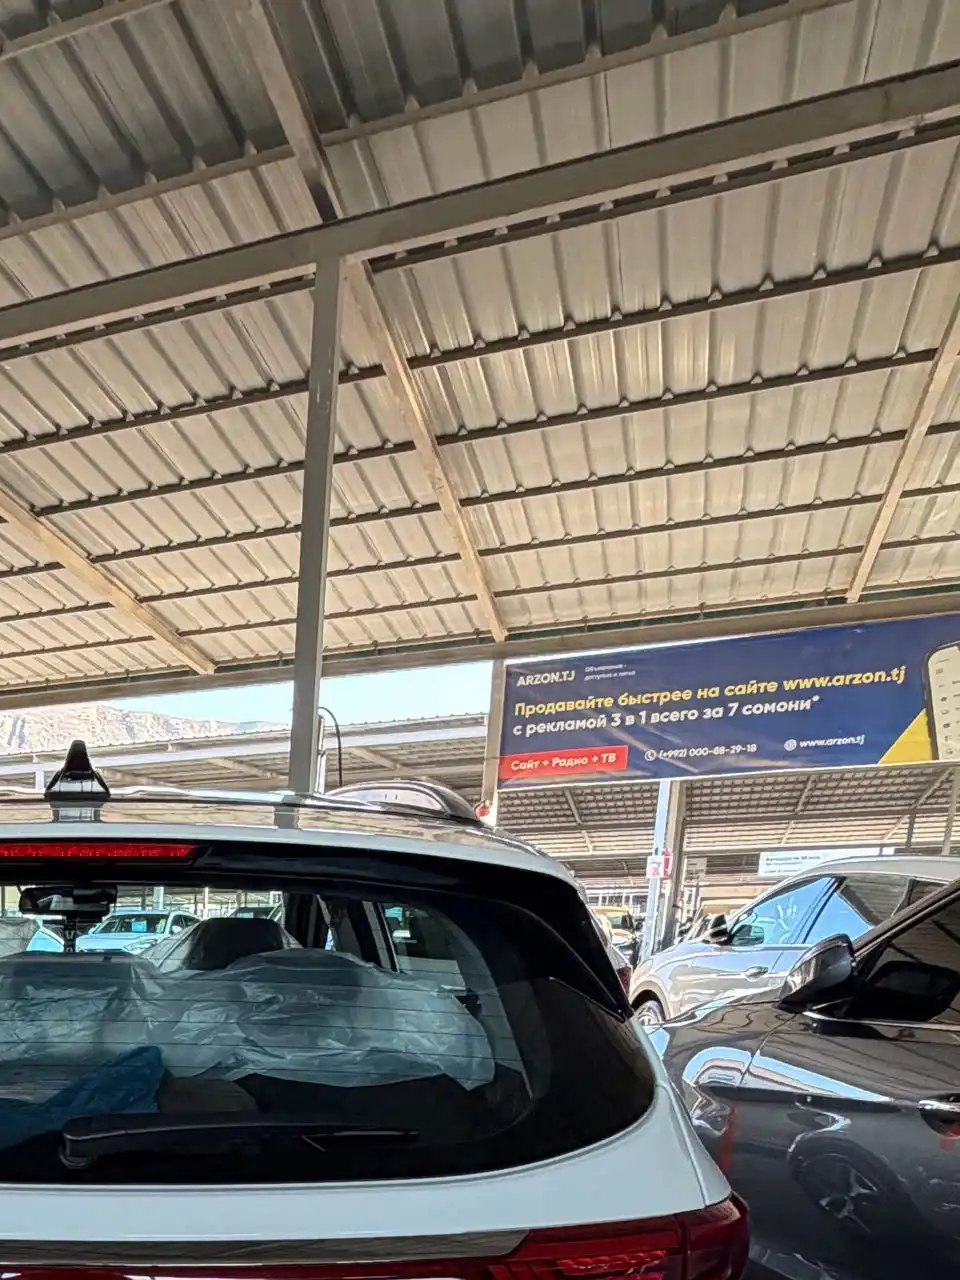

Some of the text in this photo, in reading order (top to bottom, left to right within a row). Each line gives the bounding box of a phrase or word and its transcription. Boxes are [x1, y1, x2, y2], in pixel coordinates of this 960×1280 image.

[516, 670, 576, 687] ARZON.TJ
[514, 665, 907, 718] Продавайте быстрее на сайте www.arzon.tj
[513, 725, 522, 736] с
[525, 714, 607, 738] рекламой
[611, 712, 621, 727] 3
[625, 715, 635, 726] в
[639, 710, 647, 724] 1
[650, 709, 699, 724] всего
[702, 707, 724, 719] за
[727, 702, 740, 717] 7
[799, 734, 866, 748] www.arzon.tj
[510, 759, 539, 771] Сайт
[551, 756, 588, 768] Радио
[601, 752, 617, 763] ТВ
